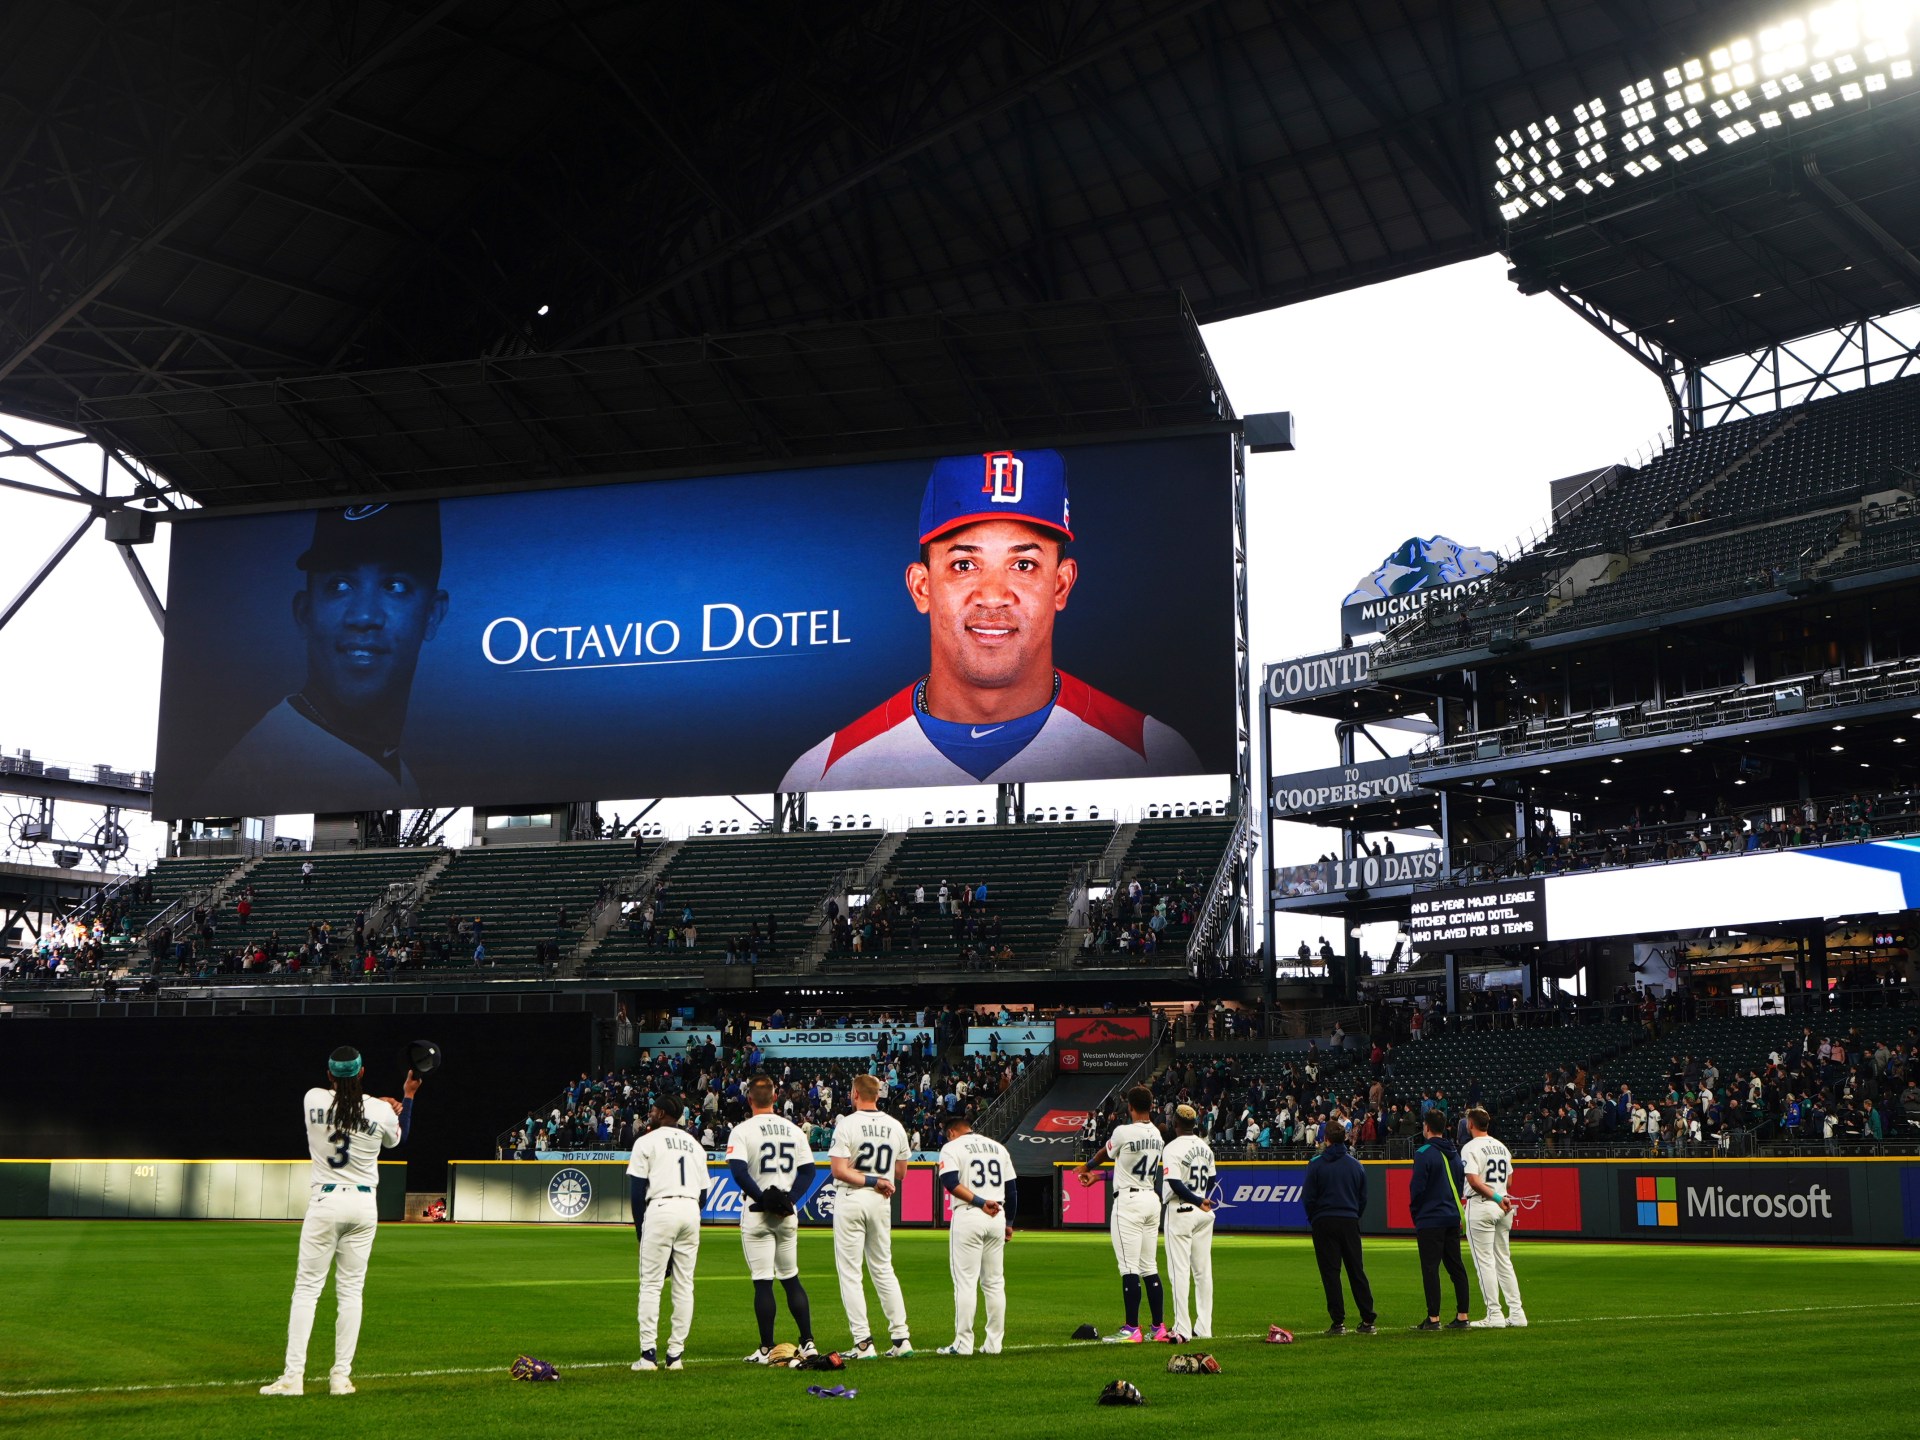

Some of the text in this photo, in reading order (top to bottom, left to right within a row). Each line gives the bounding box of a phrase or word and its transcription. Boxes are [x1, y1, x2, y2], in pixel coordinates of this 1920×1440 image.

[1344, 768, 1360, 782] TO
[1275, 773, 1415, 811] COOPERSTOW
[1334, 852, 1437, 890] 110 DAYS
[1411, 903, 1428, 914] AND
[1468, 895, 1498, 908] MAJOR
[1500, 891, 1535, 905] LEAGUE
[1412, 915, 1446, 928] PITCHER
[1449, 912, 1485, 924] OCTAVIO
[1412, 921, 1534, 942] WHO PLAYED FOR 13 TEAMS
[778, 1032, 833, 1043] J-ROD
[1082, 1060, 1103, 1068] Toyota
[759, 1124, 792, 1137] MOORE
[861, 1125, 892, 1139] RALEY
[327, 1130, 351, 1169] 3
[666, 1137, 694, 1153] BLISS
[965, 1144, 999, 1155] SOLANO
[760, 1142, 795, 1173] 25
[855, 1142, 893, 1174] 20
[1131, 1155, 1159, 1181] 44
[134, 1165, 155, 1177] 401
[552, 1171, 588, 1188] SEATTLE
[678, 1156, 685, 1186] 1
[970, 1159, 1002, 1187] 39
[1188, 1165, 1208, 1191] 56
[1486, 1159, 1506, 1182] 29
[1231, 1185, 1303, 1203] BOEI
[1687, 1184, 1832, 1218] Microsoft
